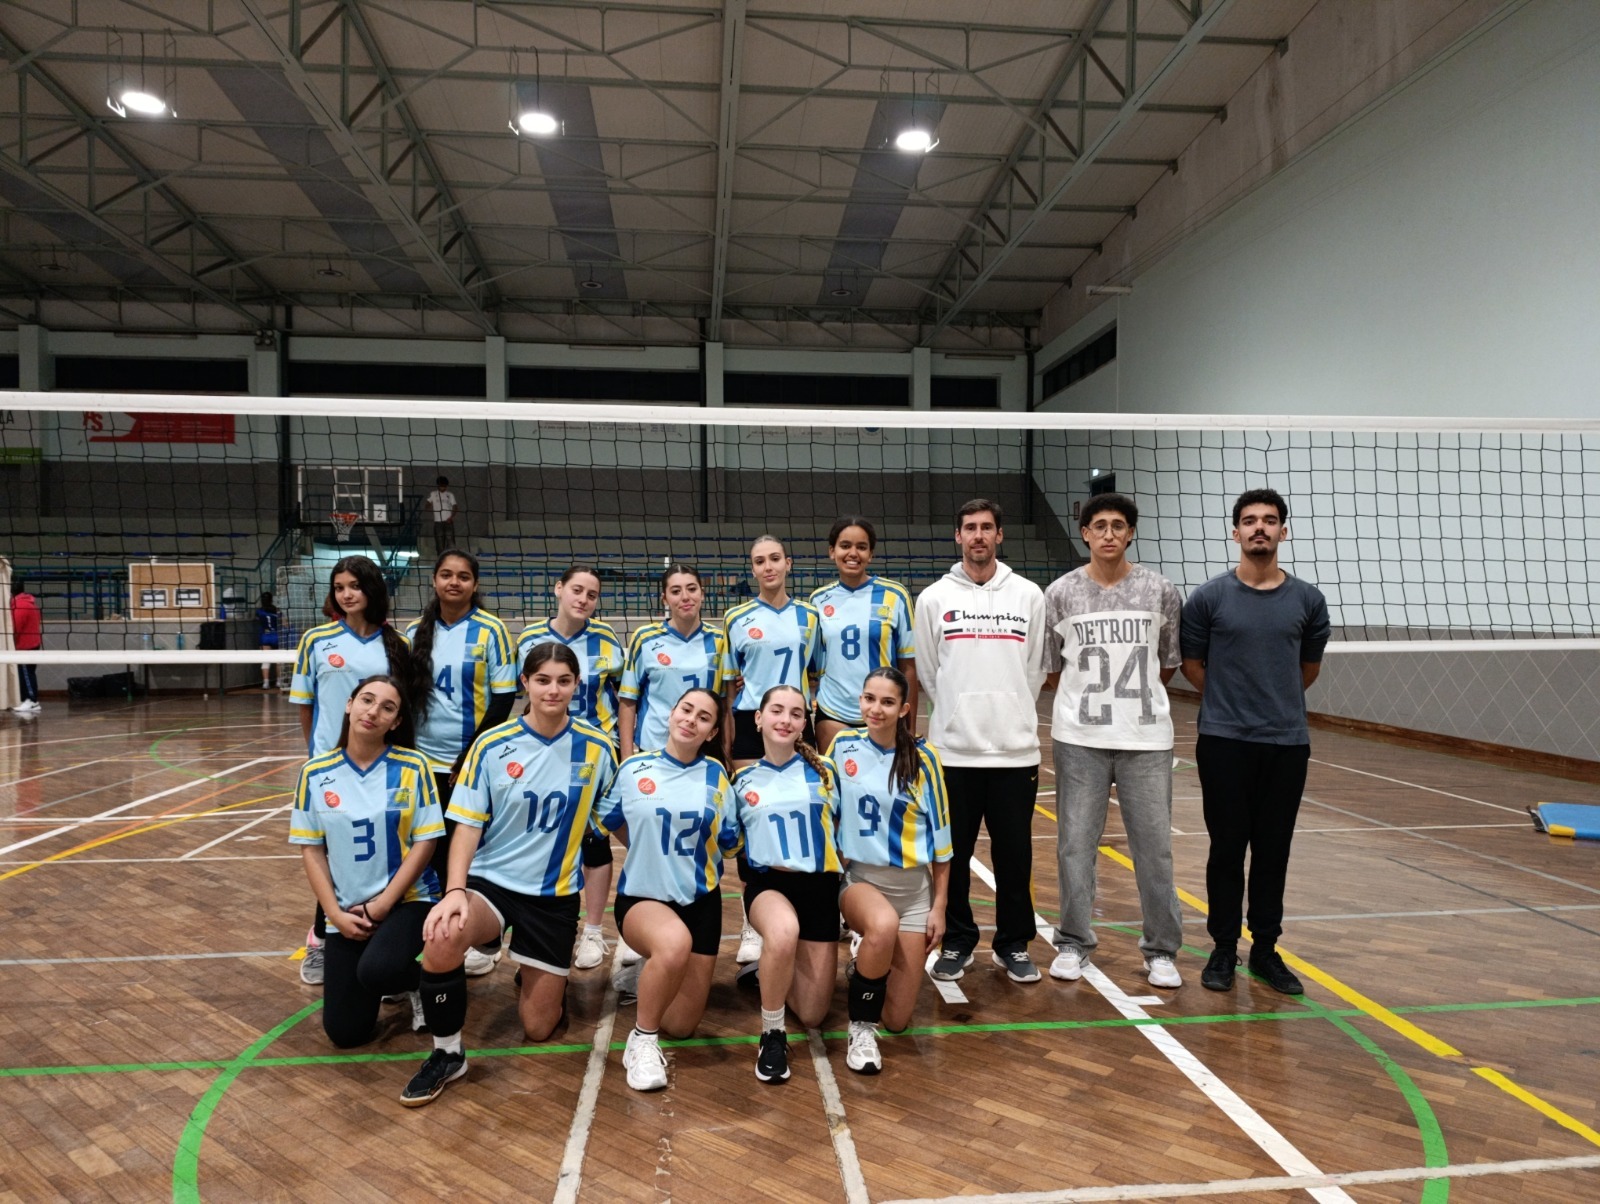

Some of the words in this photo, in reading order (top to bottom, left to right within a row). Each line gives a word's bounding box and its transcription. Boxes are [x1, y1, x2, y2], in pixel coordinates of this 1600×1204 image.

[943, 610, 1028, 625] Champion
[1073, 619, 1152, 646] DETROIT
[841, 624, 860, 660] 8
[436, 665, 454, 700] 4
[774, 647, 793, 684] 7
[1078, 646, 1156, 725] 24
[523, 790, 567, 833] 10
[656, 807, 702, 856] 12
[858, 794, 881, 837] 9
[352, 818, 375, 862] 3
[768, 810, 810, 860] 11
